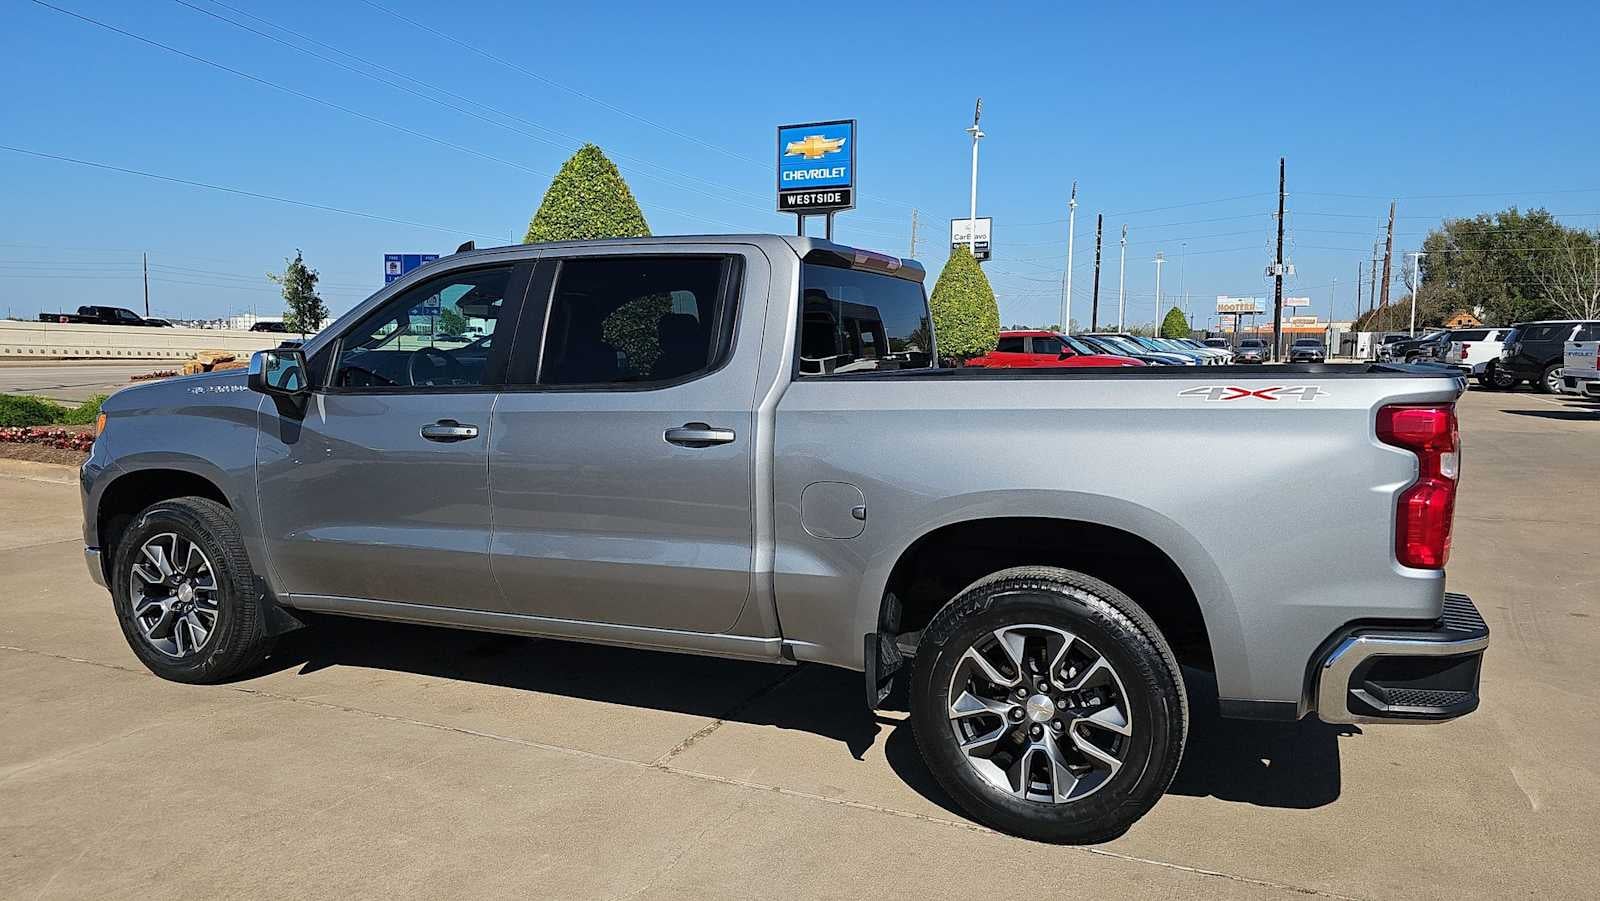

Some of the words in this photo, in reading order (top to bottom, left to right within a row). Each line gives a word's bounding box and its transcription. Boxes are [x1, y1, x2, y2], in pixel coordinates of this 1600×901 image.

[783, 167, 846, 181] CHEVROLET
[787, 193, 842, 205] WESTSIDE
[953, 233, 988, 241] CarBavo
